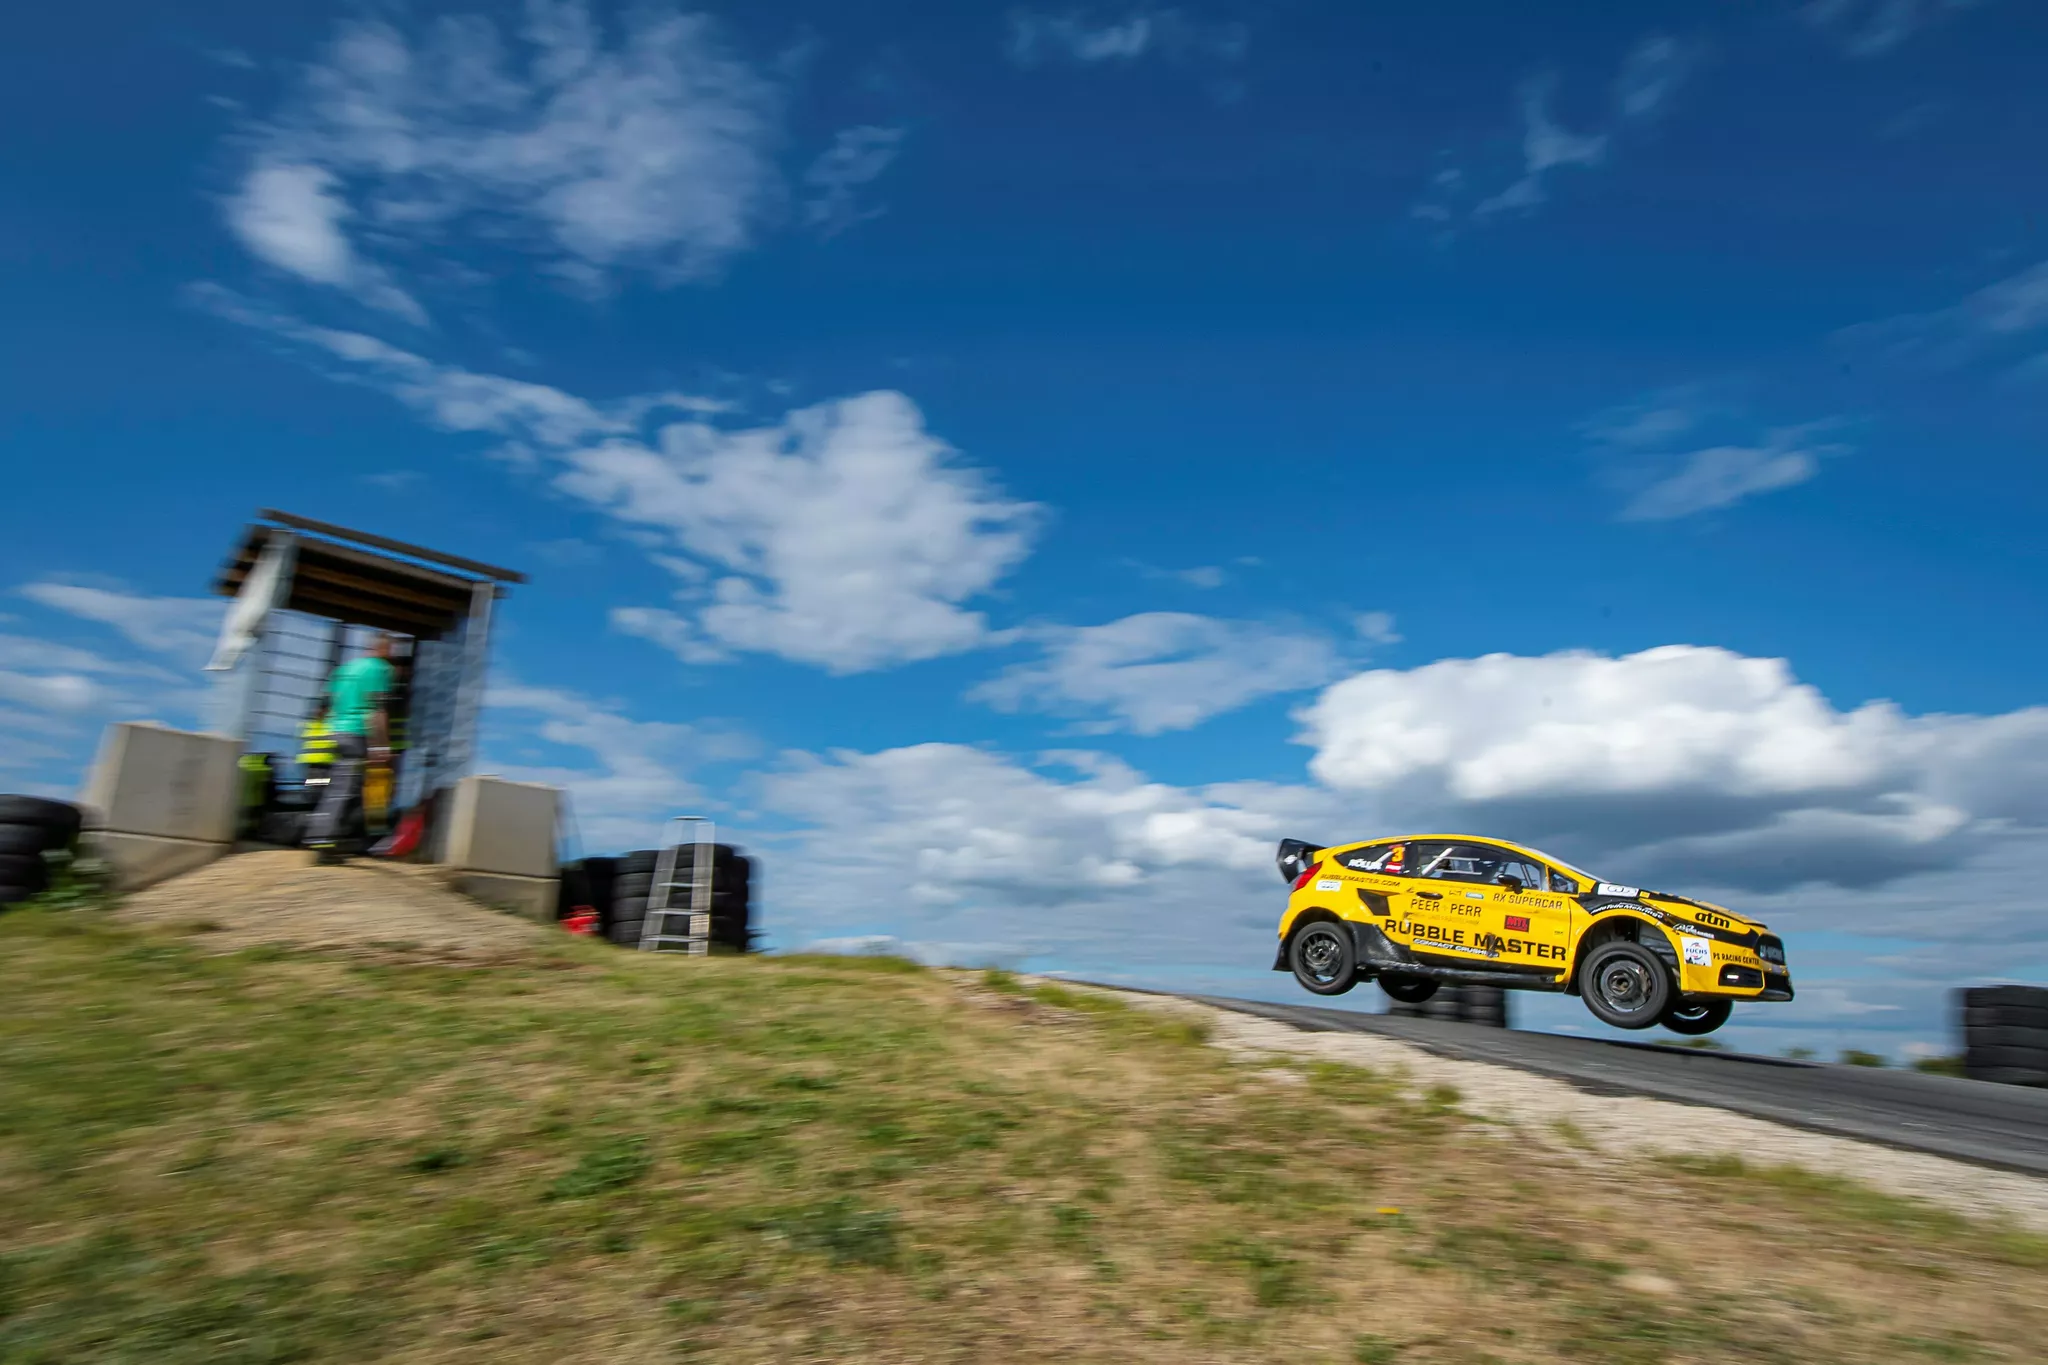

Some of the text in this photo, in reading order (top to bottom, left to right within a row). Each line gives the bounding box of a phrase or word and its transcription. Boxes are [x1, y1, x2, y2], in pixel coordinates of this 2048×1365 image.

[1391, 847, 1405, 862] 3
[1411, 899, 1482, 917] PEER PERR
[1493, 893, 1506, 902] RX
[1508, 895, 1563, 910] SUPERCAR
[1384, 919, 1465, 944] RUBBLE
[1474, 933, 1566, 961] MASTER
[1414, 938, 1454, 950] COMPACT
[1722, 953, 1742, 963] RACING
[1743, 956, 1760, 966] CENTER
